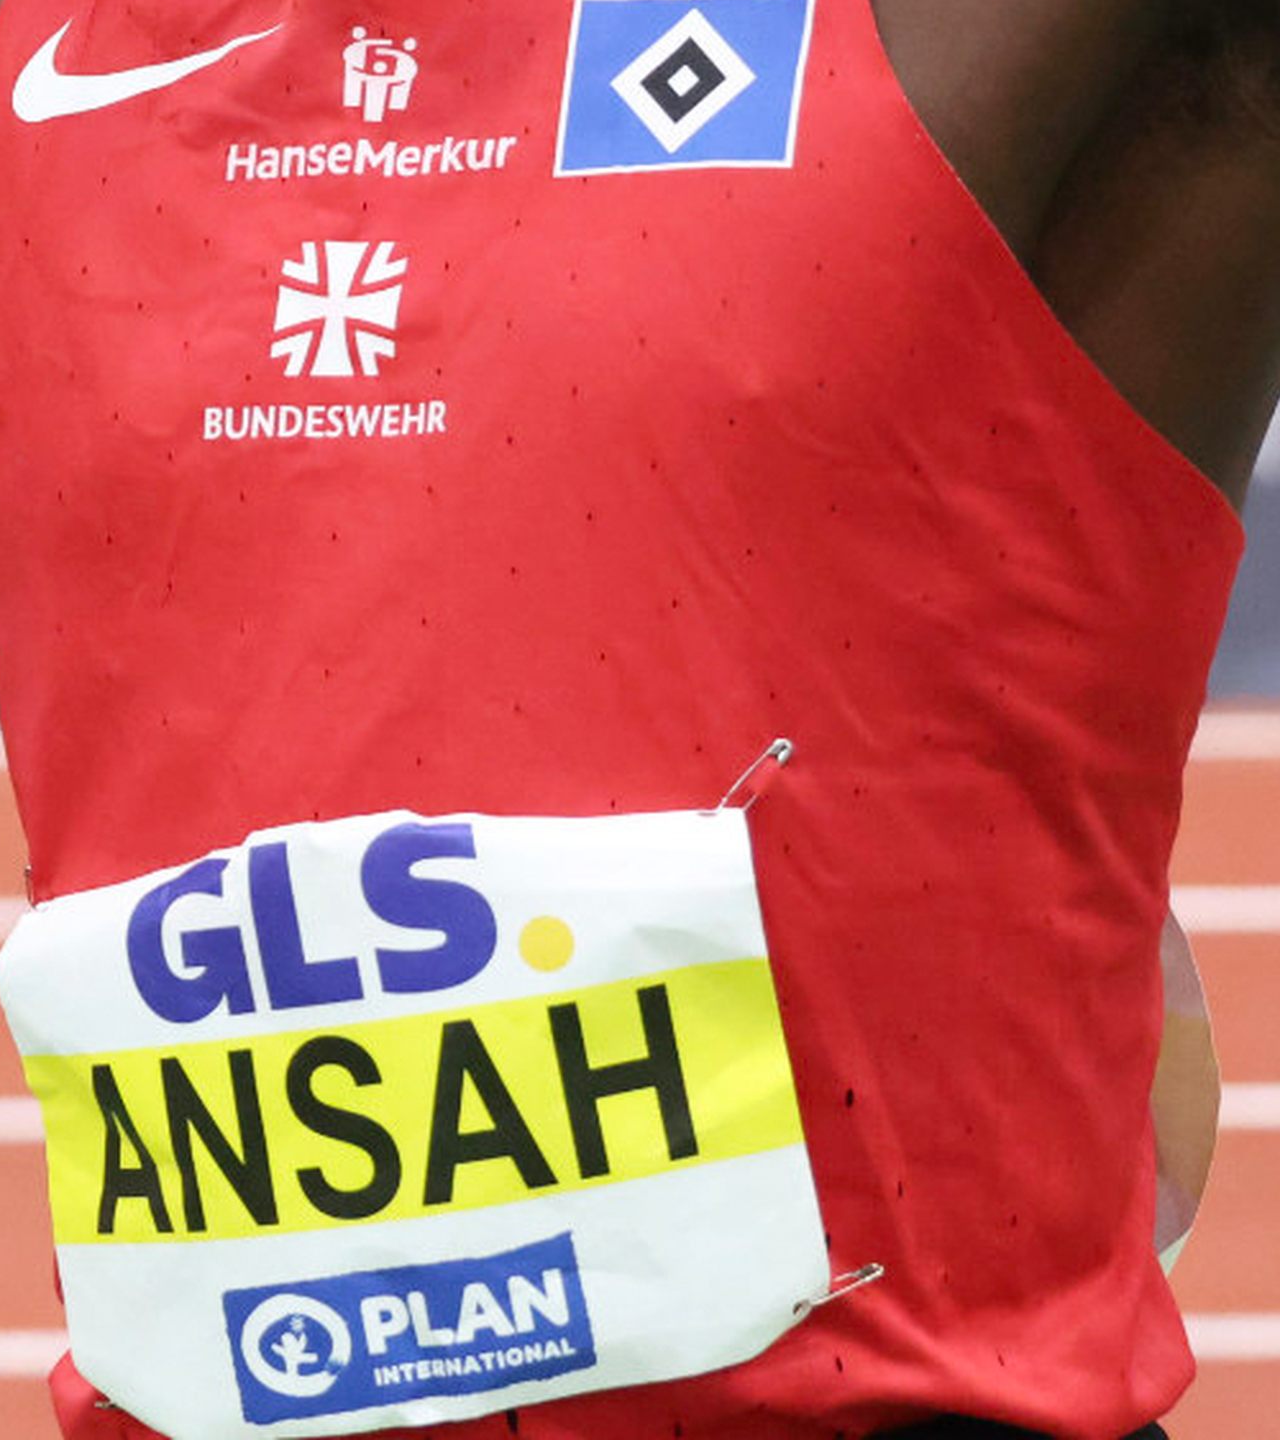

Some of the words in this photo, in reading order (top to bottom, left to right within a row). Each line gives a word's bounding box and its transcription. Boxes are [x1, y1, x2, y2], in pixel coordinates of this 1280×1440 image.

[224, 135, 517, 182] HanseMerkur
[202, 399, 447, 441] BUNDESWEHR
[90, 983, 700, 1235] ANSAH
[360, 1267, 570, 1356] PLAN
[373, 1336, 577, 1387] INTERNATIONAL
